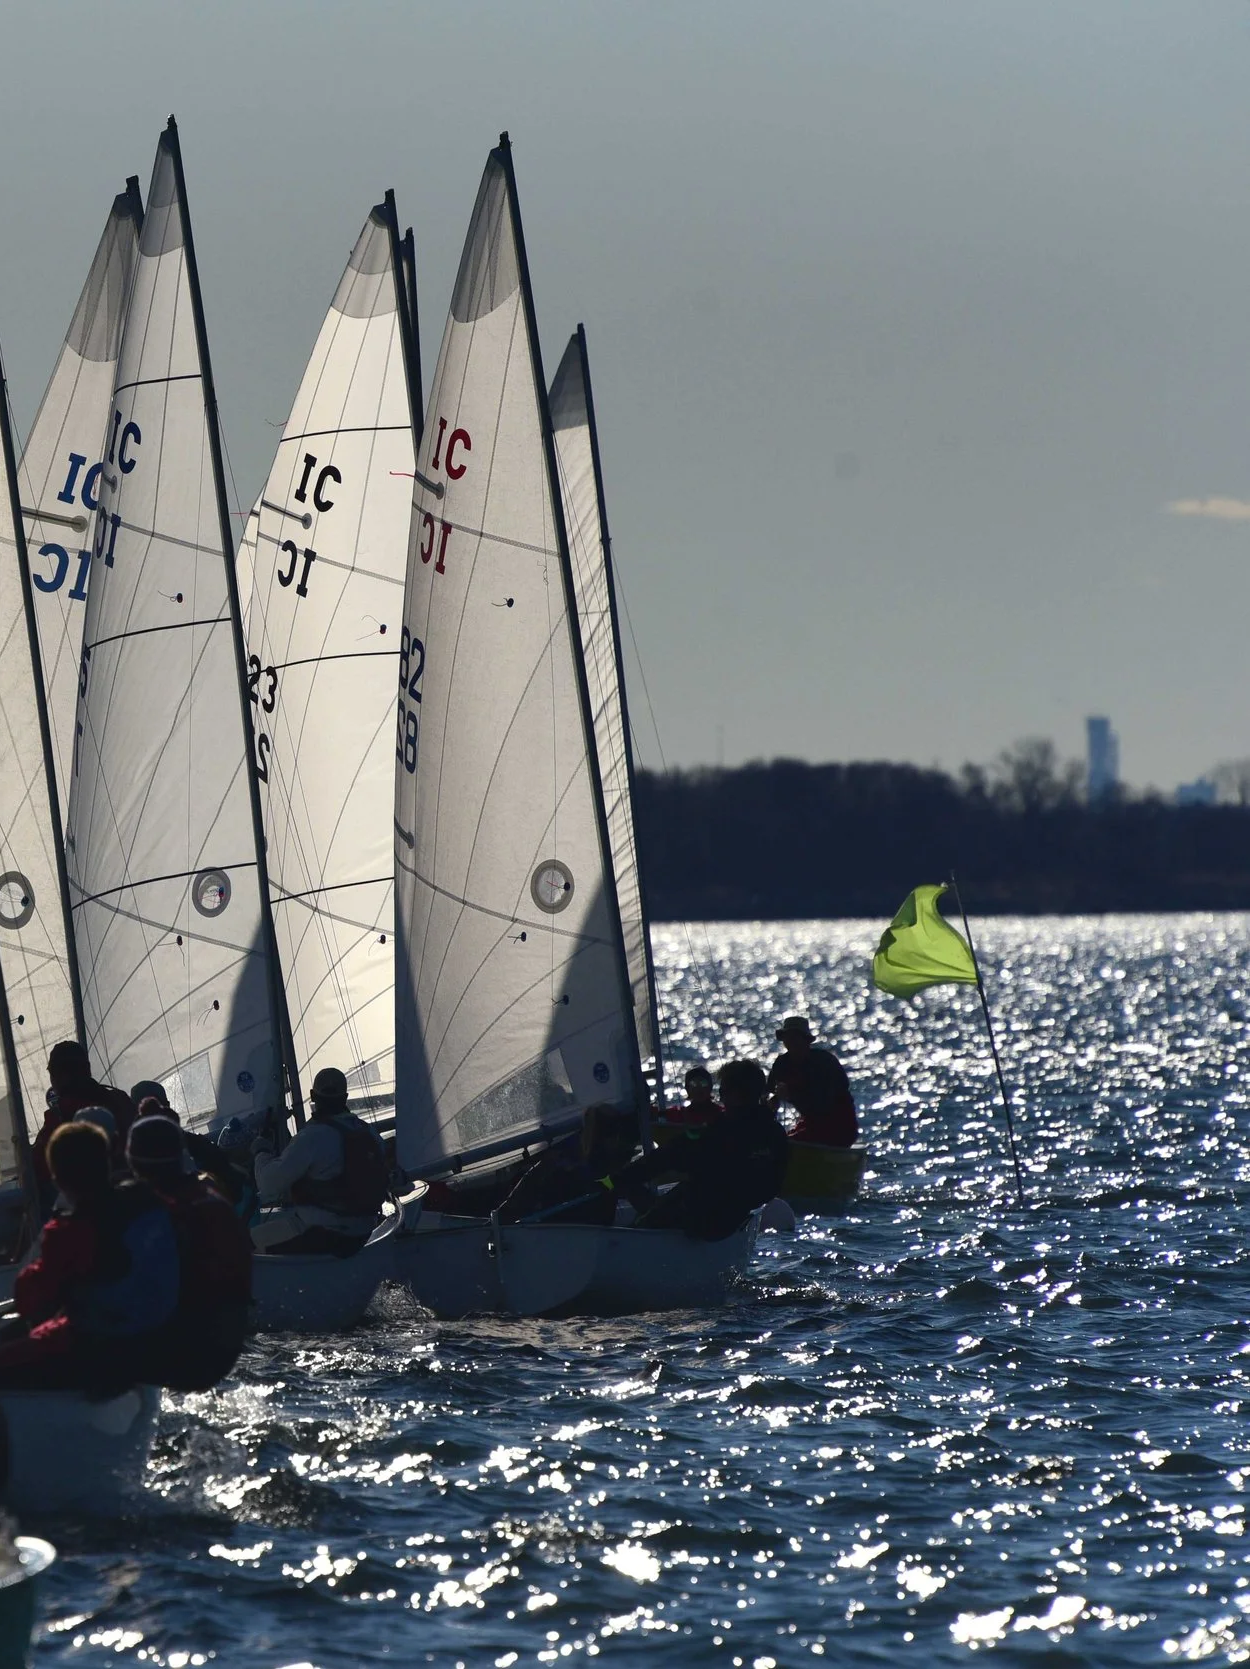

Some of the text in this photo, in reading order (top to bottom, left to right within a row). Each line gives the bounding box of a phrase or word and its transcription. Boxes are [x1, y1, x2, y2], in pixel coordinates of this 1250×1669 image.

[108, 410, 142, 474] IC
[430, 416, 472, 481] IC
[294, 453, 342, 513] IC
[248, 654, 278, 713] 23
[399, 625, 425, 704] 82
